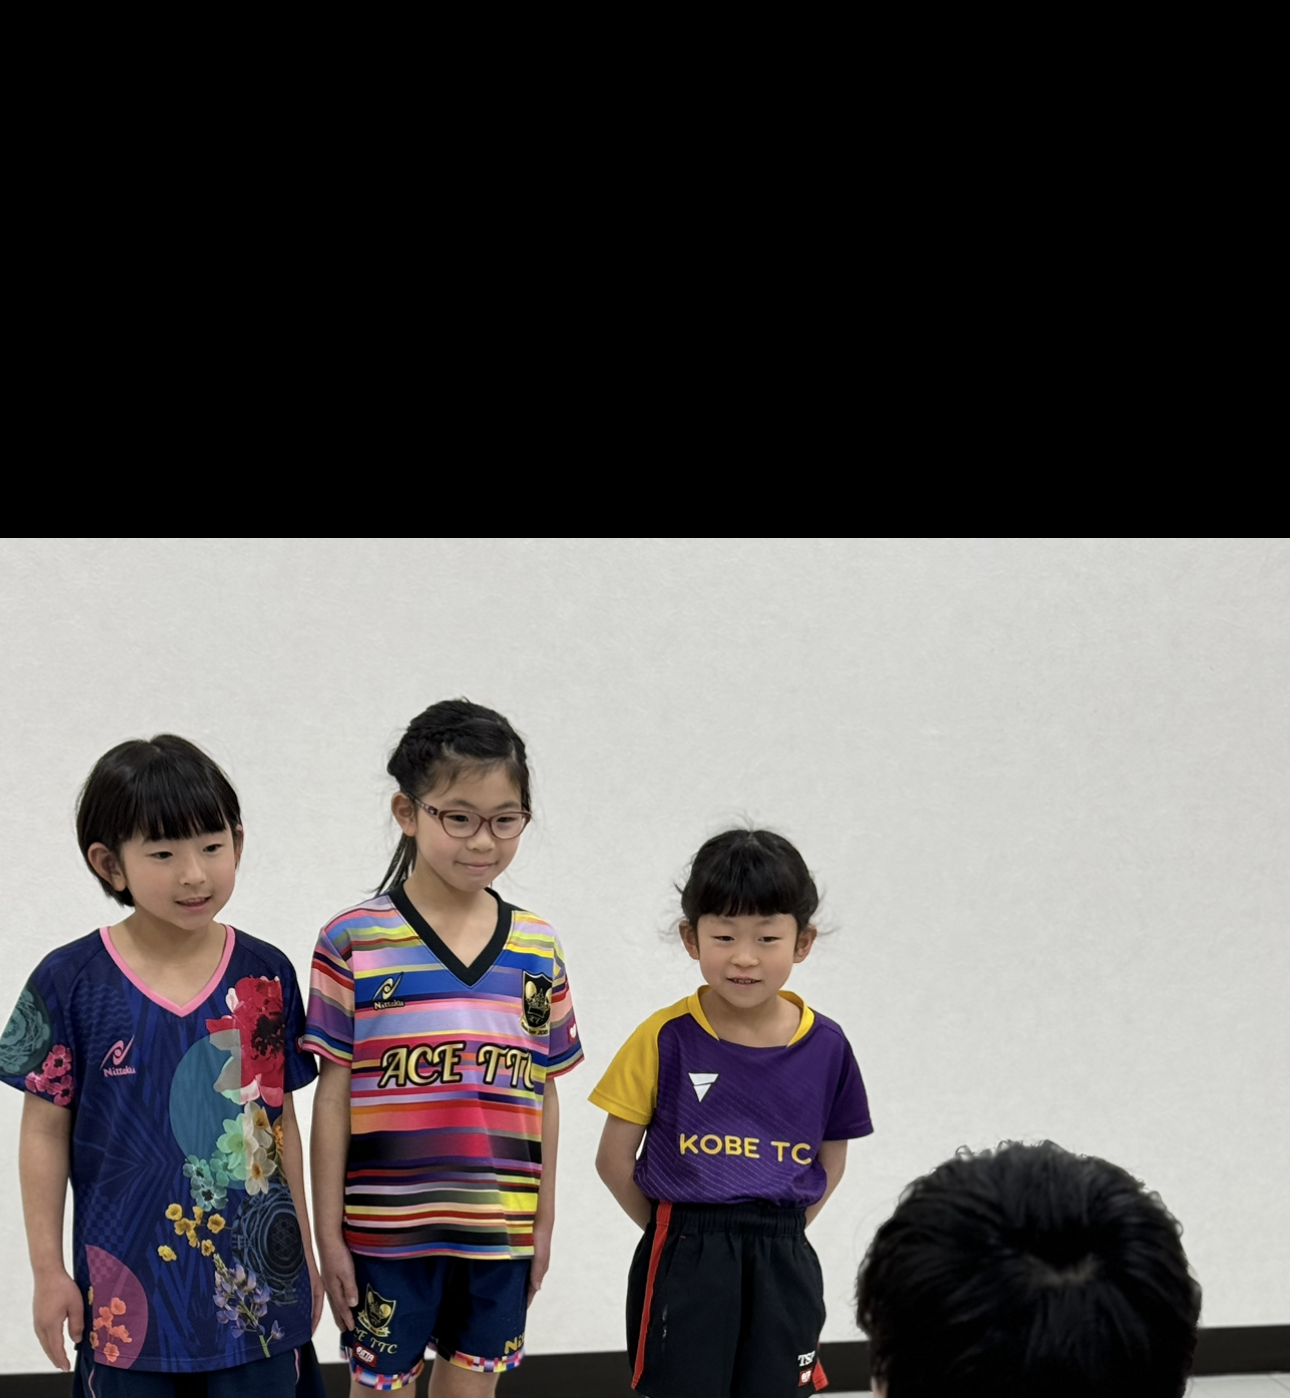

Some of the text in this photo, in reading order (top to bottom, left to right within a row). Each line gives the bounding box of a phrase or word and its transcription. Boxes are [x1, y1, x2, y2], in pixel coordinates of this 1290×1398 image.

[373, 1000, 405, 1010] Nittaku
[103, 1065, 136, 1077] Nittaku
[378, 1041, 466, 1087] ACE
[680, 1133, 812, 1165] KOBE TC
[370, 1337, 398, 1354] TTC
